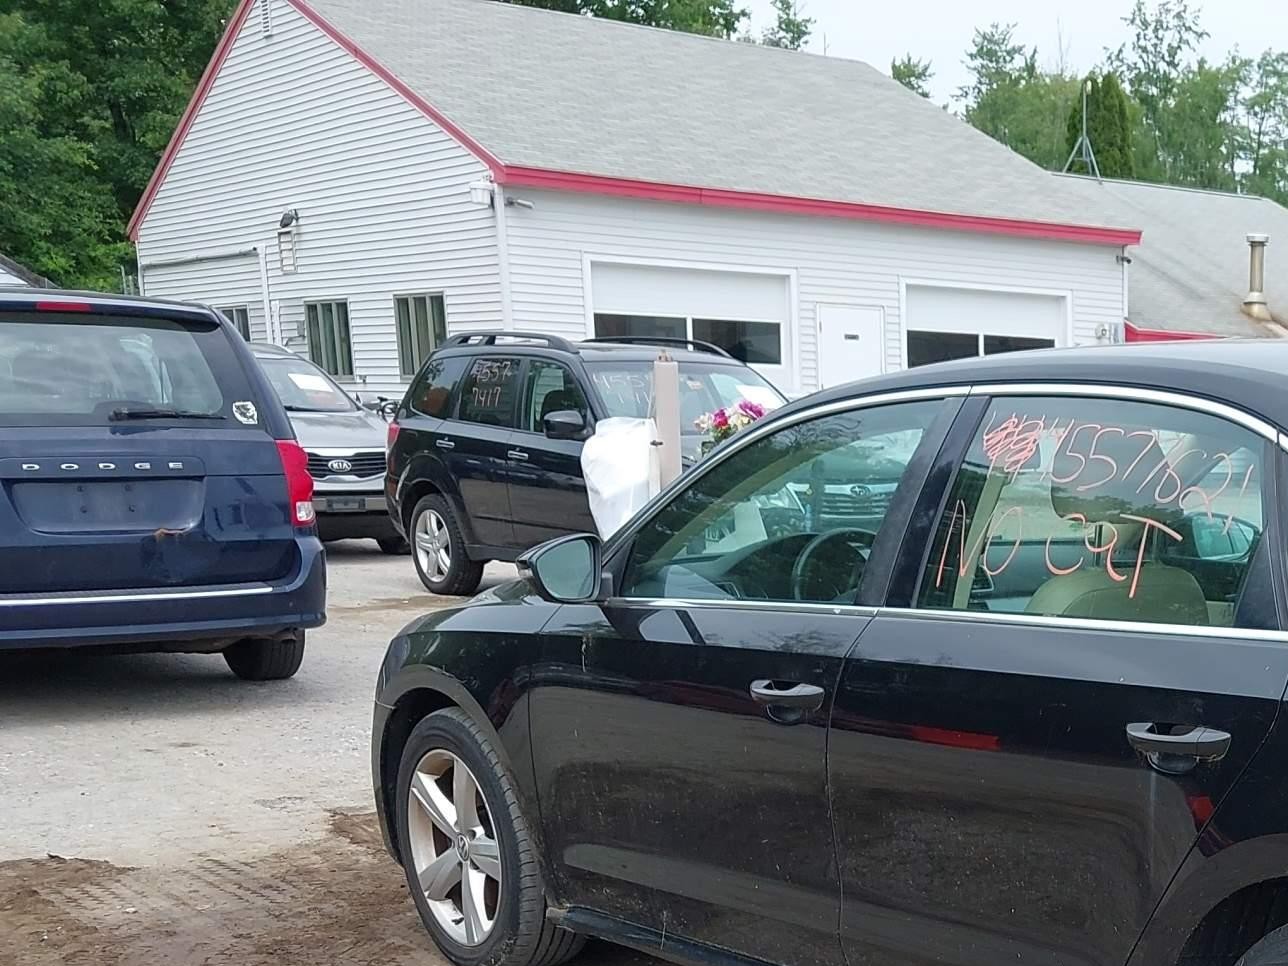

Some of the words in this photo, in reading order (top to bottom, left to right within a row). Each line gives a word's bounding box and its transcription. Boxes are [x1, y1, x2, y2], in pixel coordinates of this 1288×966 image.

[22, 462, 183, 471] DODGE
[331, 462, 350, 470] KIA
[936, 499, 1023, 589] NO
